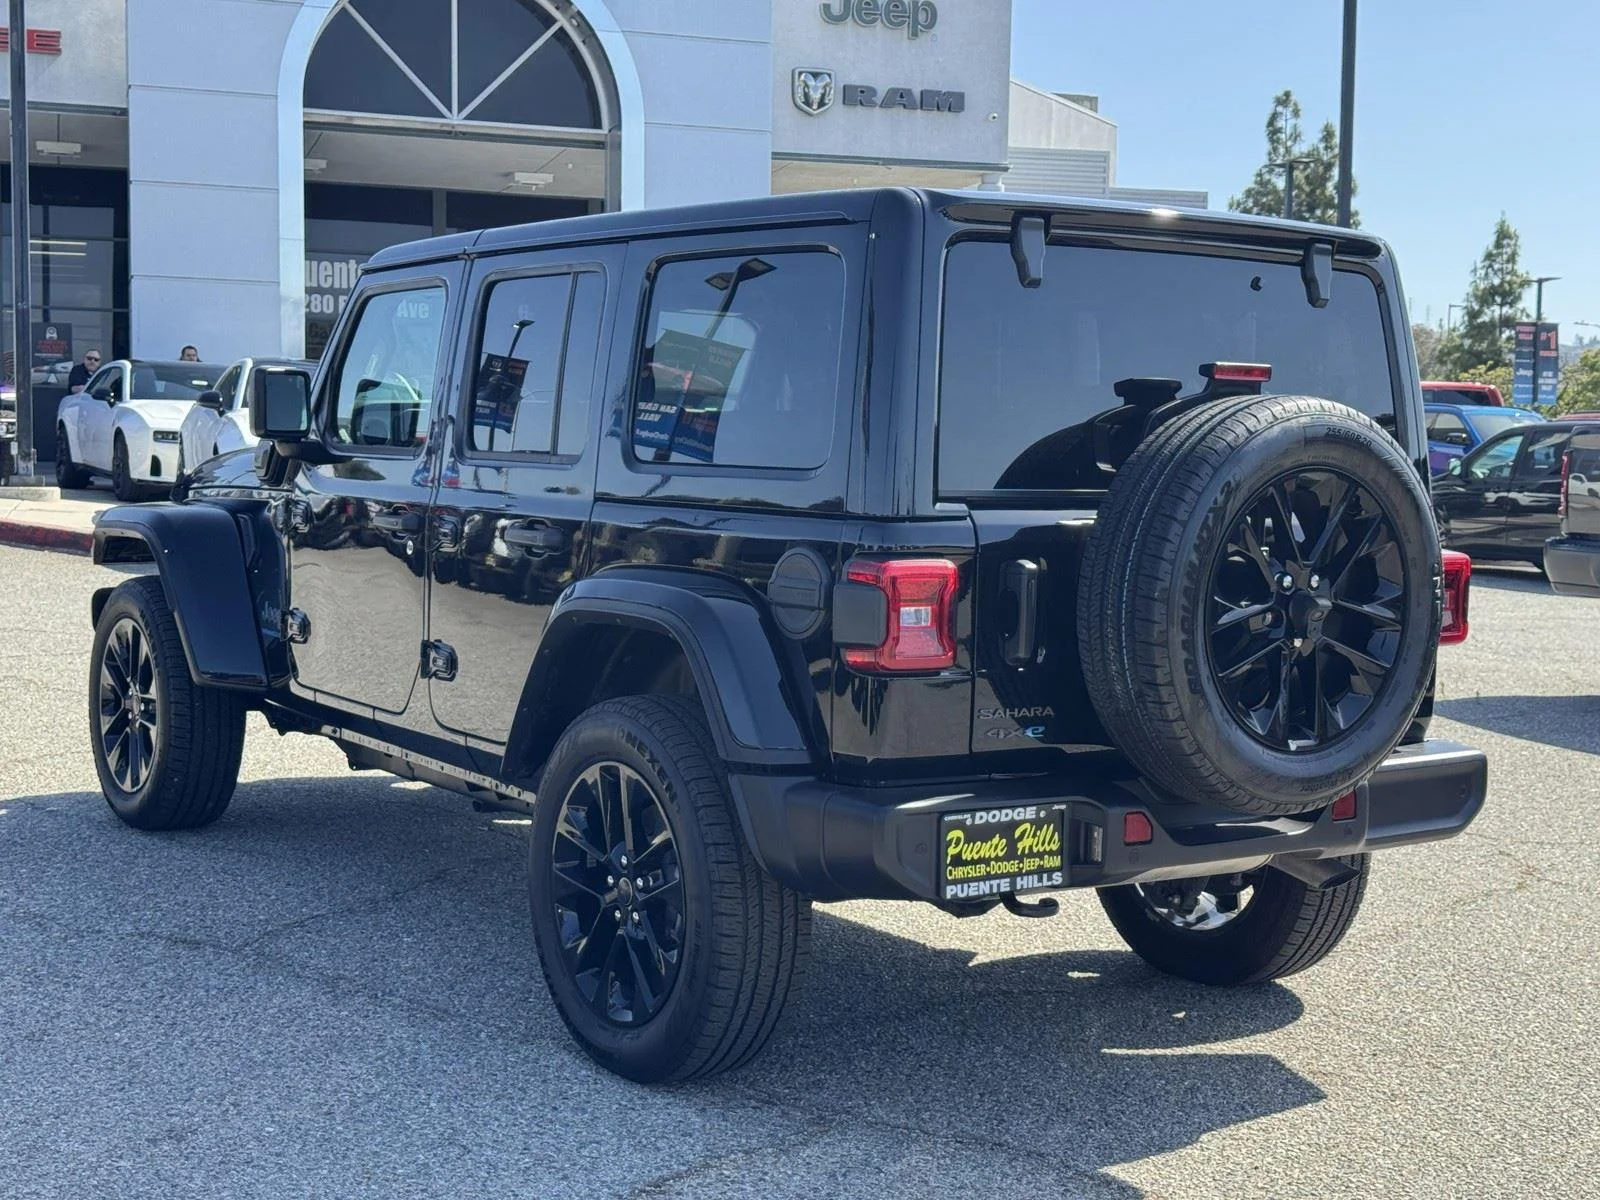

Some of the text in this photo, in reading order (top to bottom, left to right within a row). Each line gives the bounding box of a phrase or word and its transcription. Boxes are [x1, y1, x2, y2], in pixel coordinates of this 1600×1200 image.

[820, 0, 938, 40] Jeep
[843, 84, 965, 113] RAM
[396, 300, 430, 319] Ave
[1325, 427, 1373, 449] 255/60R20
[978, 706, 1054, 720] SAHARA
[625, 730, 677, 804] NEXEN
[974, 806, 1037, 825] DODGE
[946, 822, 1060, 865] Puente Hills
[946, 871, 1063, 900] PUENTE HILLS
